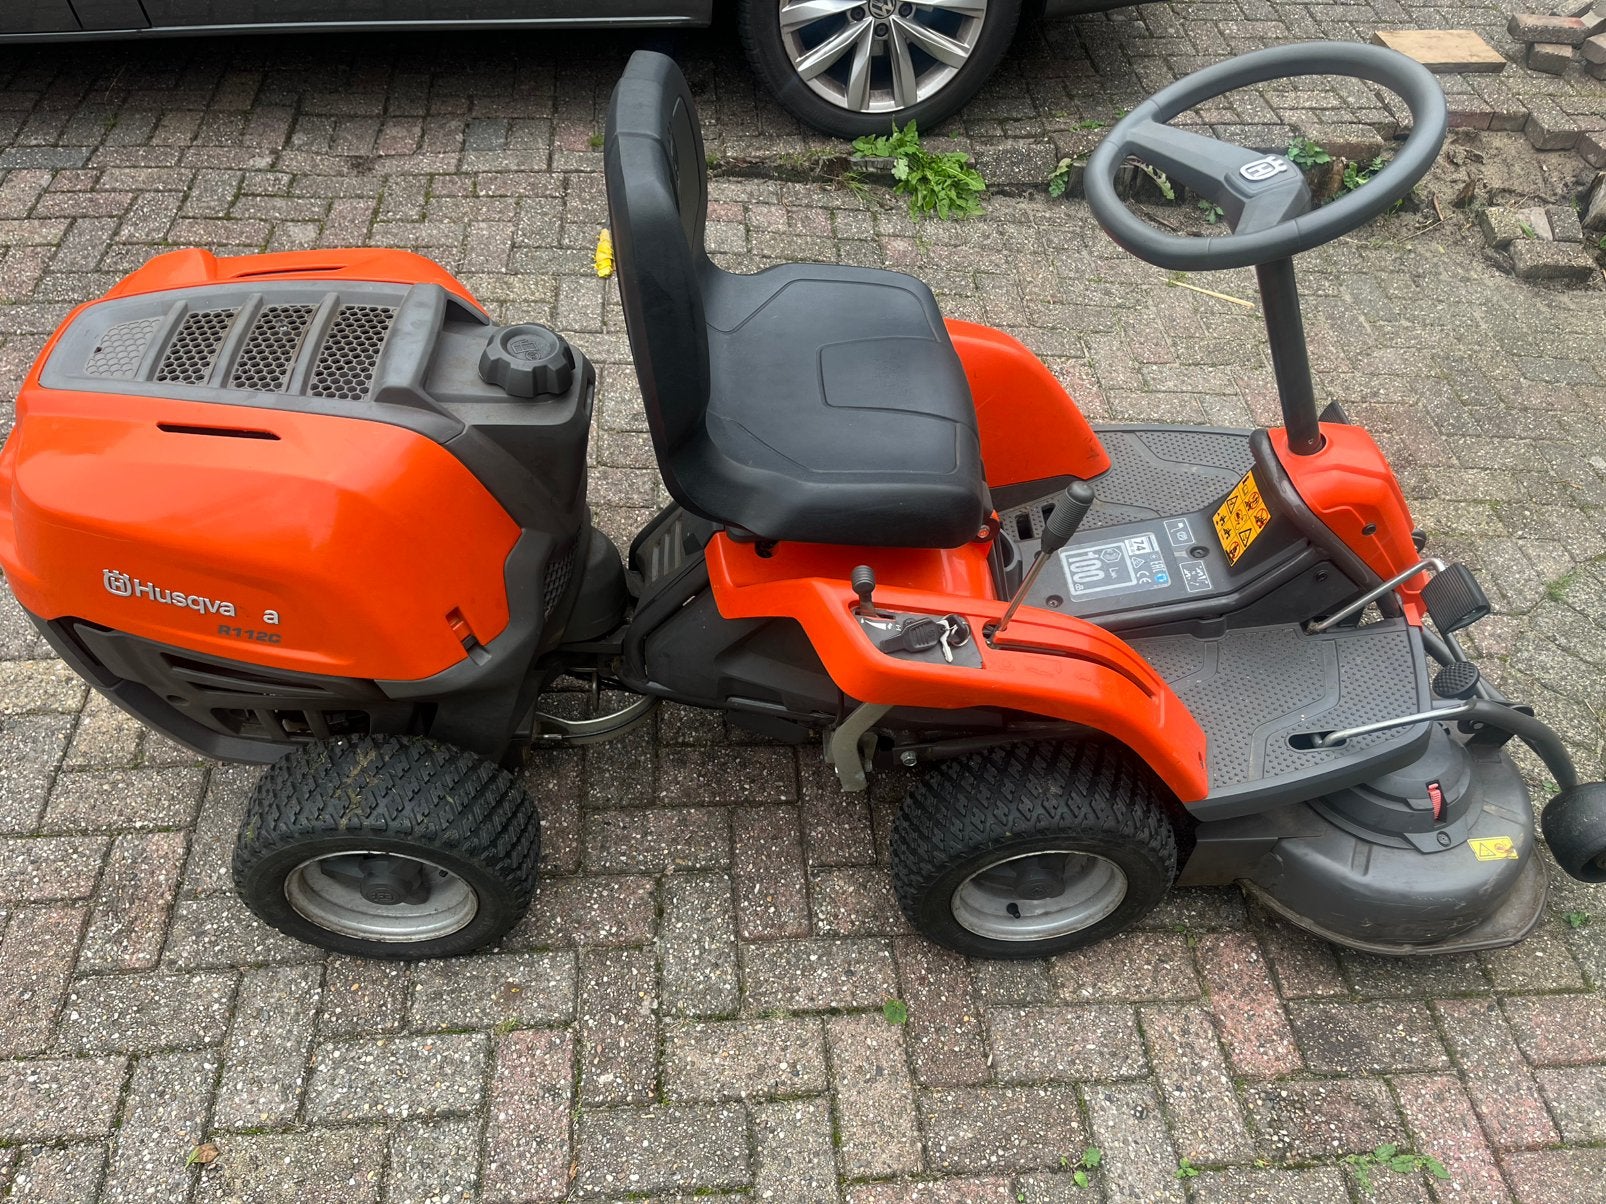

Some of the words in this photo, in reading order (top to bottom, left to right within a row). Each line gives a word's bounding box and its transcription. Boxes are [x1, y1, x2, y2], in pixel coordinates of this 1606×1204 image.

[1133, 539, 1147, 552] 74
[1068, 551, 1105, 583] 100
[1136, 570, 1152, 585] CE
[218, 625, 281, 643] R112C
